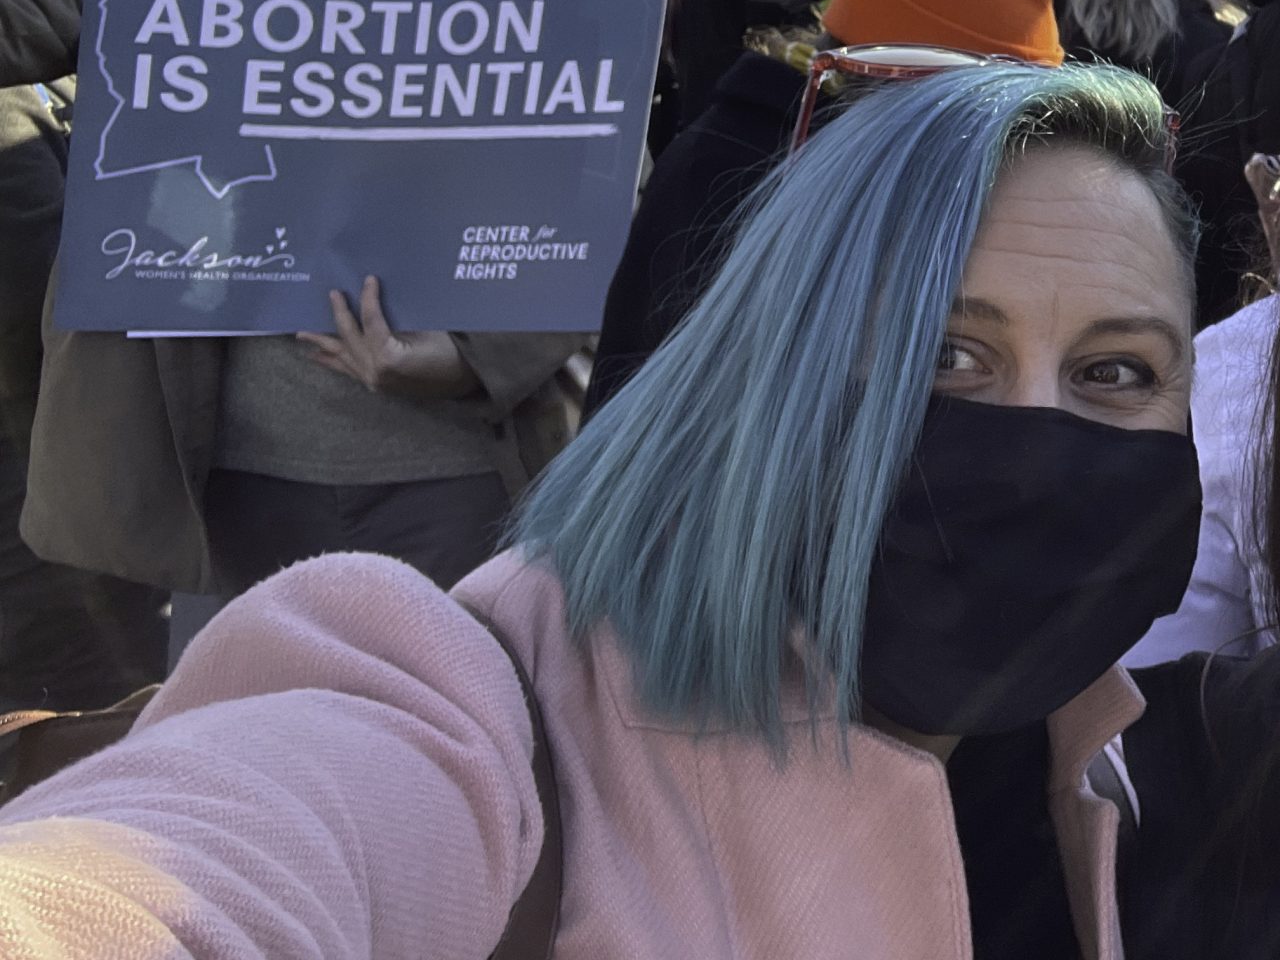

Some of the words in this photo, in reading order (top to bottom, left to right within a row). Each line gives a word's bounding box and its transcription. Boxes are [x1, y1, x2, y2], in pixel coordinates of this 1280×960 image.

[132, 53, 209, 113] IS
[242, 58, 626, 118] ESSENTIAL
[463, 225, 531, 243] CENTER
[531, 224, 558, 242] for
[458, 242, 590, 262] REPRODUCTIVE
[135, 269, 186, 281] WOMEN'S
[189, 270, 230, 281] HEALTH
[232, 270, 311, 282] ORGANIZATION
[454, 262, 518, 281] RIGHTS
